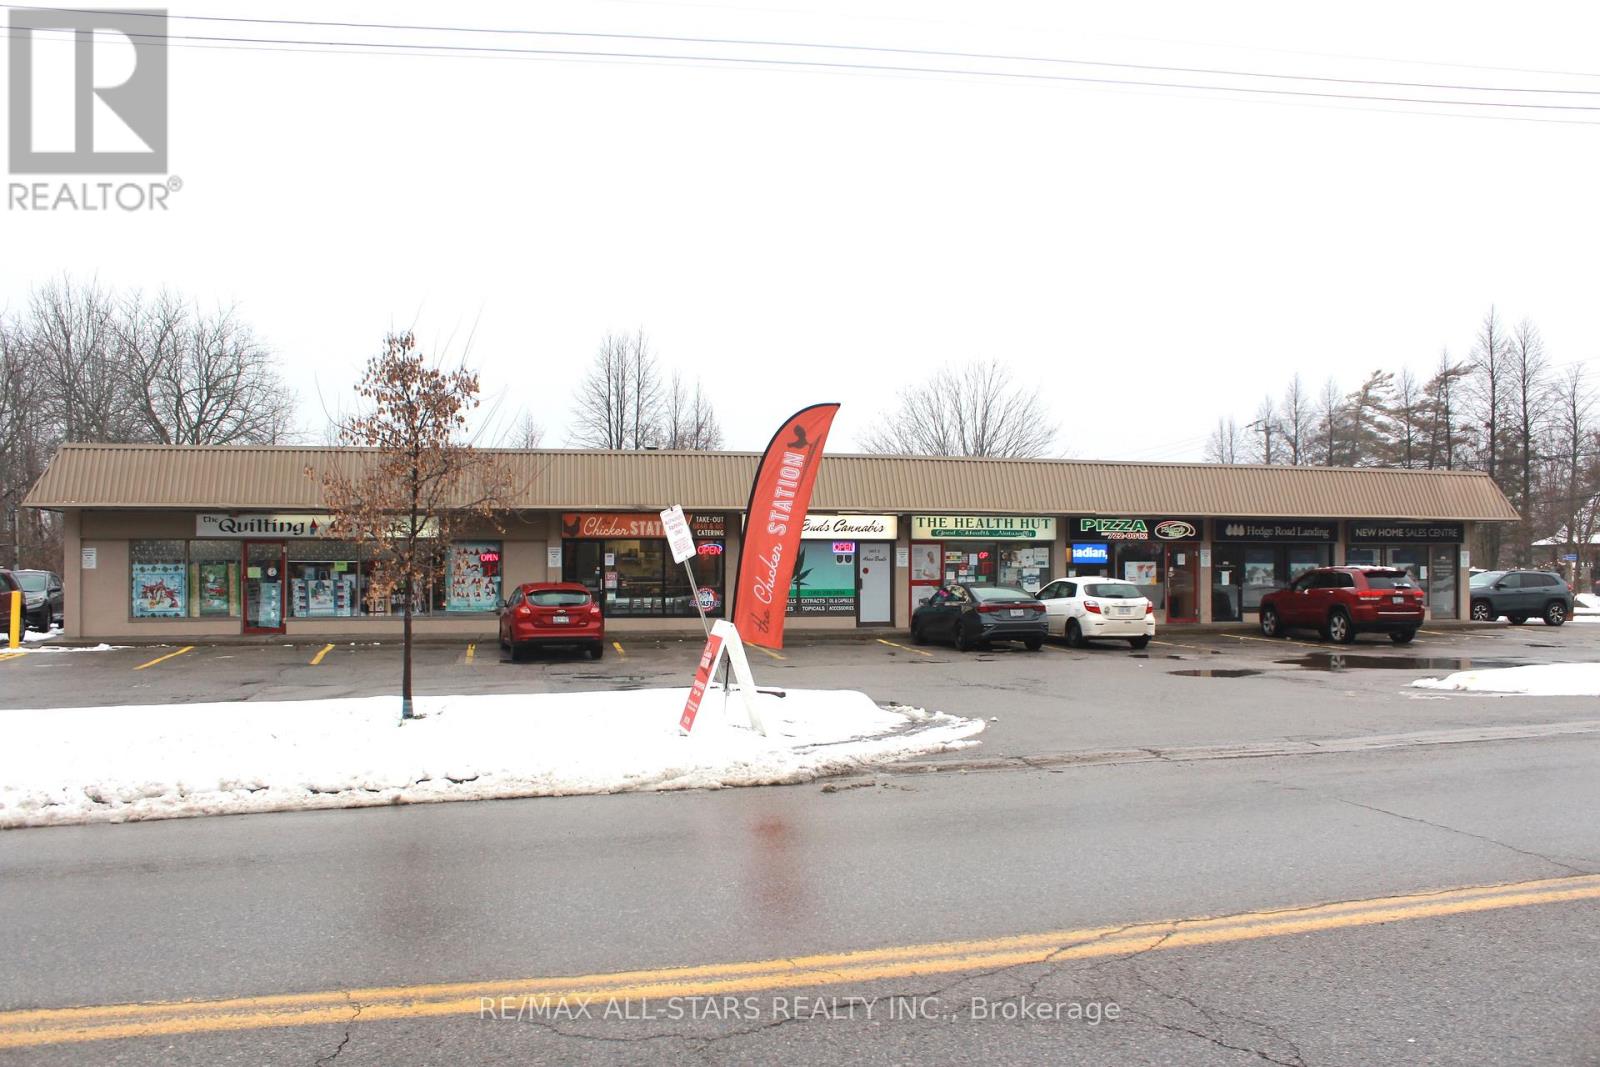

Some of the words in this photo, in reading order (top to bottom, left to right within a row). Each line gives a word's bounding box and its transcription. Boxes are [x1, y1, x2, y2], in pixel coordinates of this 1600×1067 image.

[766, 451, 805, 536] STATION
[218, 518, 305, 536] Quilting
[583, 516, 630, 536] Chicken
[833, 519, 885, 532] Cannabis
[916, 517, 947, 528] THE
[954, 518, 1014, 528] HEALTH
[1020, 518, 1051, 529] HUT
[1080, 519, 1149, 532] PIZZA
[1275, 526, 1295, 536] Road
[1298, 526, 1330, 538] Landing
[1355, 528, 1376, 537] NEW
[1378, 528, 1404, 537] HOME
[1405, 528, 1427, 537] SALES
[1428, 528, 1458, 537] CENTRE
[697, 545, 721, 555] OPEN
[834, 543, 854, 551] OPEN
[480, 553, 499, 562] OPEN
[753, 543, 783, 605] Chicken
